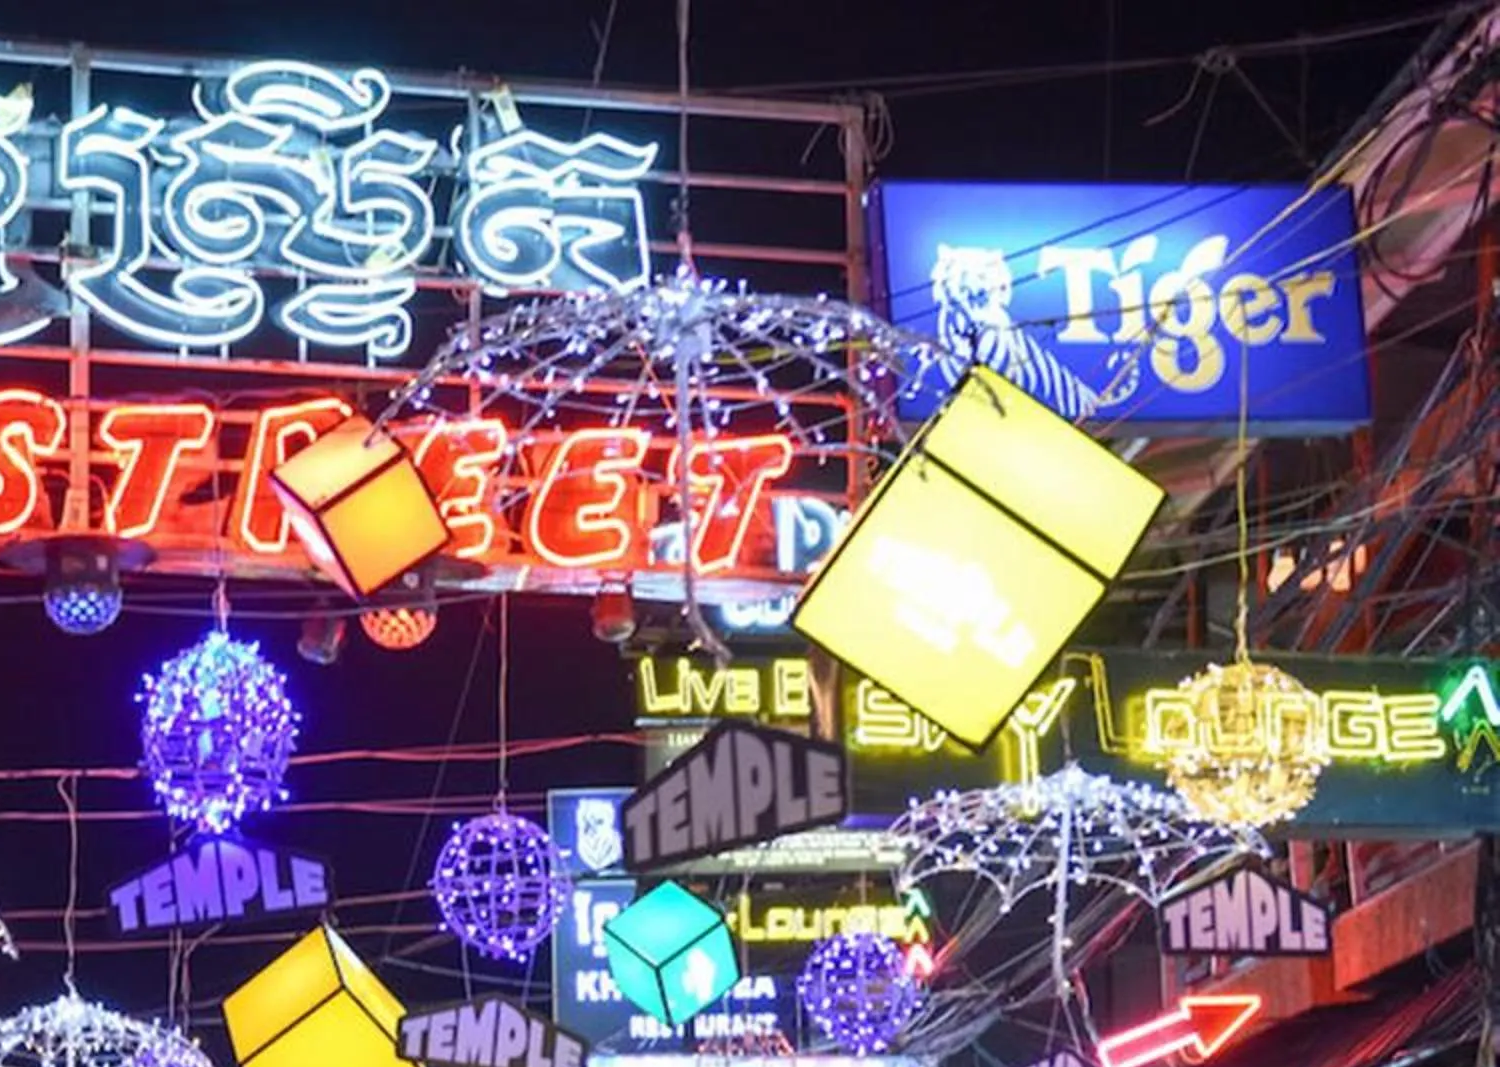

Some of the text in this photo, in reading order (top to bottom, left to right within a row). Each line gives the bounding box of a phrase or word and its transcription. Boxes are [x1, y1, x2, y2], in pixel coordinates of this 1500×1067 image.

[1040, 234, 1336, 392] Tiger
[625, 729, 841, 862] TEMPLE
[111, 840, 327, 931] TEMPLE
[1163, 870, 1328, 951] TEMPLE
